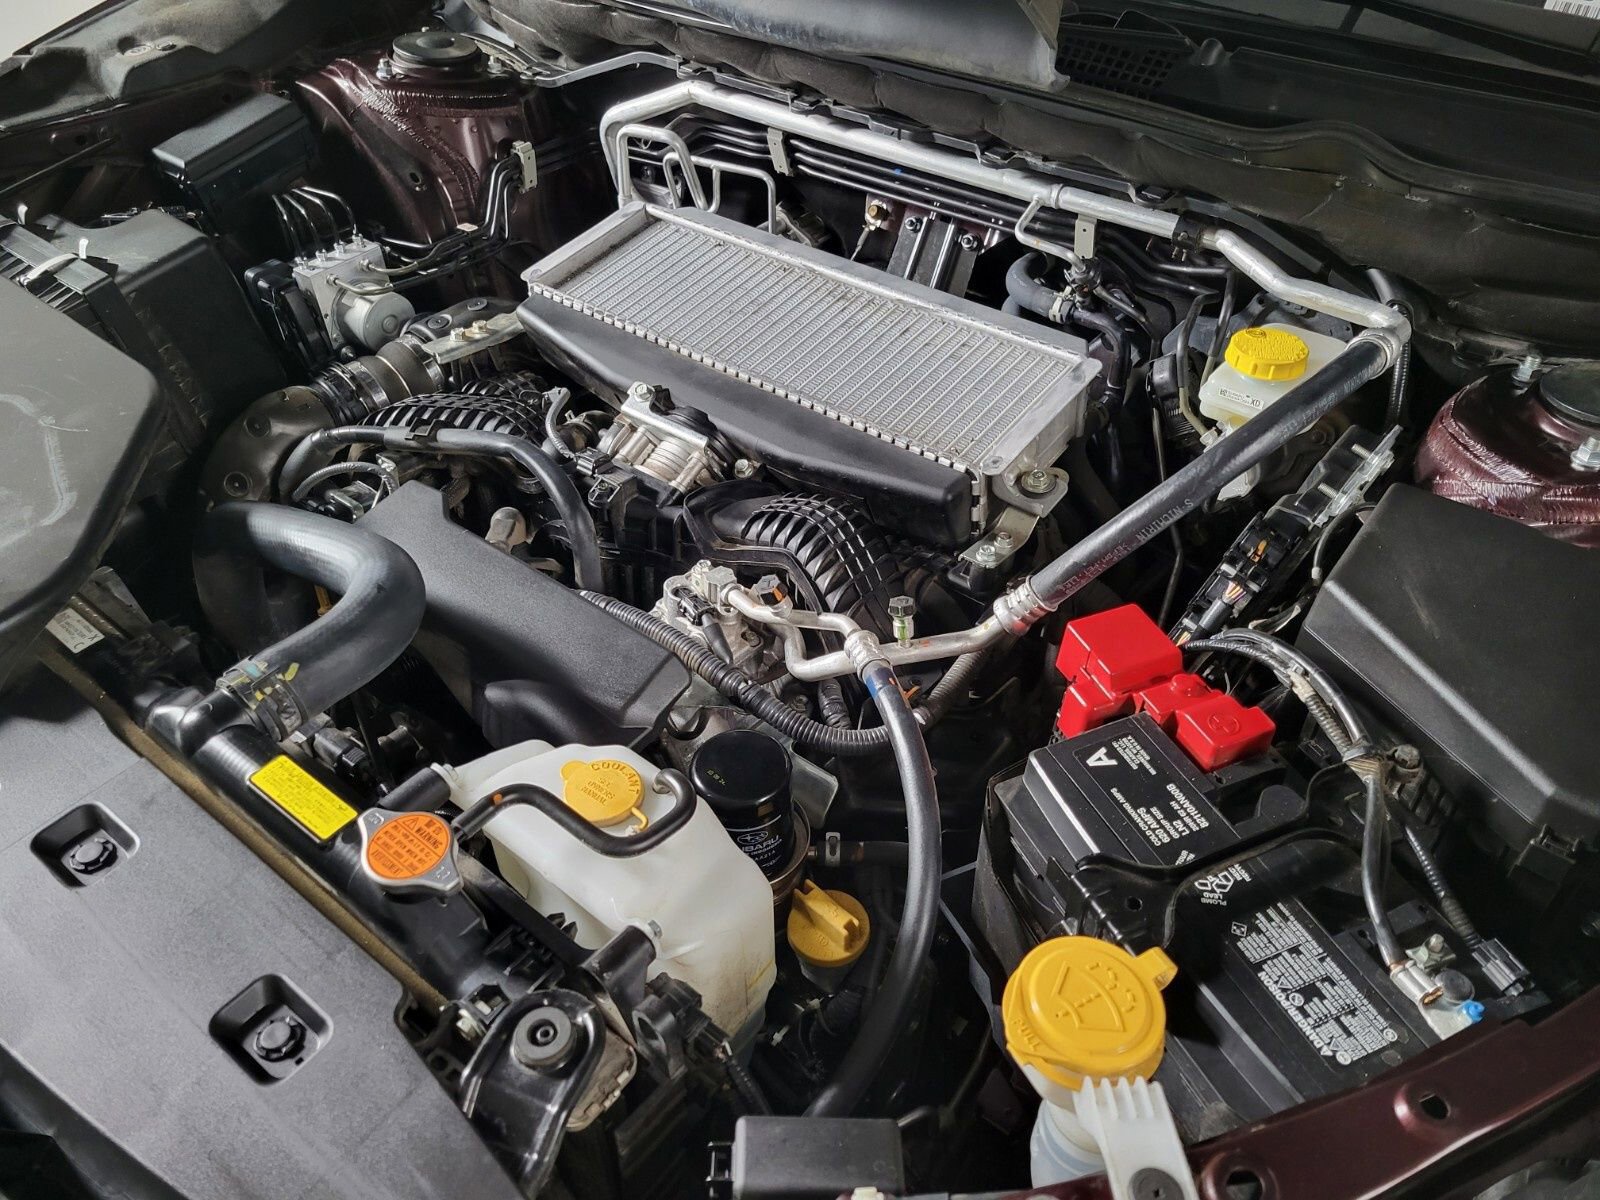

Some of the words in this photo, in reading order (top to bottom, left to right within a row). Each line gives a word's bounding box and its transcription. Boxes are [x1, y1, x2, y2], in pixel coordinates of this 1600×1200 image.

[1086, 746, 1118, 767] A
[591, 761, 640, 795] COOLANT
[1109, 787, 1126, 803] AMPS
[1149, 806, 1164, 820] SIZE
[1169, 800, 1181, 810] AH
[1136, 806, 1160, 830] AMPS
[1171, 818, 1190, 835] LN2
[414, 826, 442, 850] WARNING
[1144, 829, 1162, 846] COLD
[1154, 827, 1171, 843] 620
[1159, 818, 1180, 839] GROUP
[1203, 892, 1223, 900] LEAD
[1256, 969, 1324, 1048] DANGER/POISON
[1010, 1017, 1040, 1052] PULL
